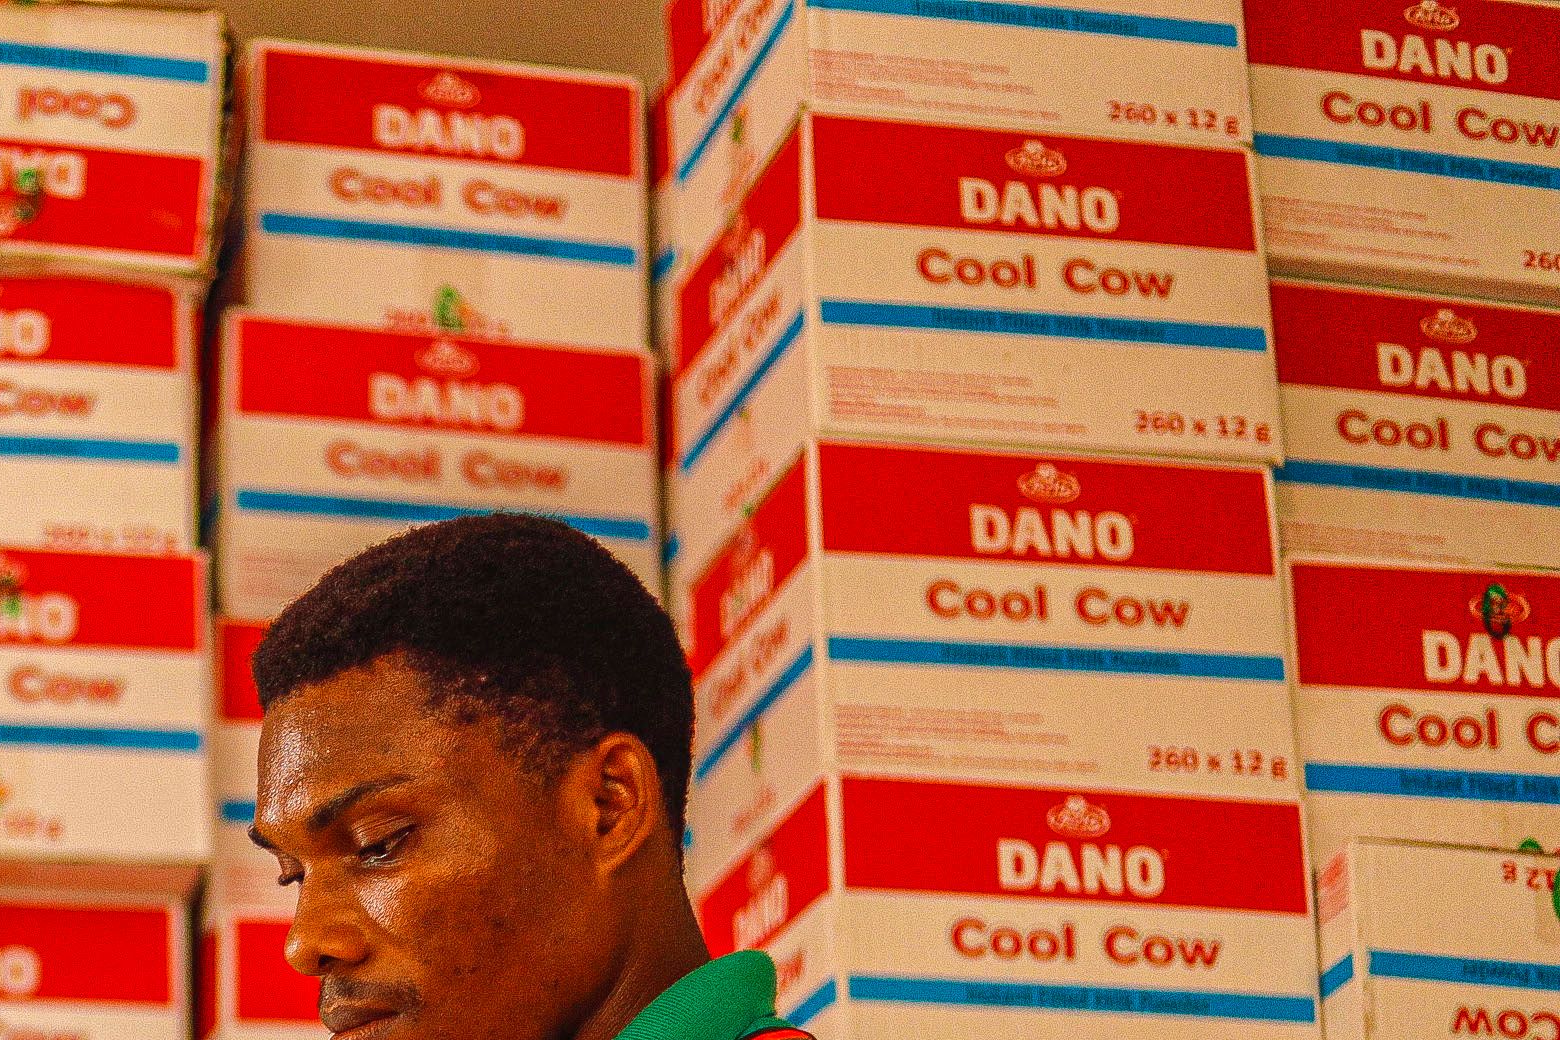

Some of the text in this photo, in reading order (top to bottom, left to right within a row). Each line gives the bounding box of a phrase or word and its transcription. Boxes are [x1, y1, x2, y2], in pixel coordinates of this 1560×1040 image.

[1361, 29, 1509, 84] DANO
[17, 87, 137, 130] Cool
[1320, 90, 1560, 149] Cool Cow
[959, 177, 1119, 232] DANO
[916, 248, 1174, 299] Cool Cow
[1377, 343, 1527, 398] DANO
[1335, 409, 1450, 451] Cool
[970, 505, 1134, 560] DANO
[925, 580, 1189, 628] Cool Cow
[7, 666, 125, 704] Cow
[1377, 704, 1499, 750] Cool
[997, 839, 1164, 897] DANO
[950, 918, 1220, 968] Cool Cow
